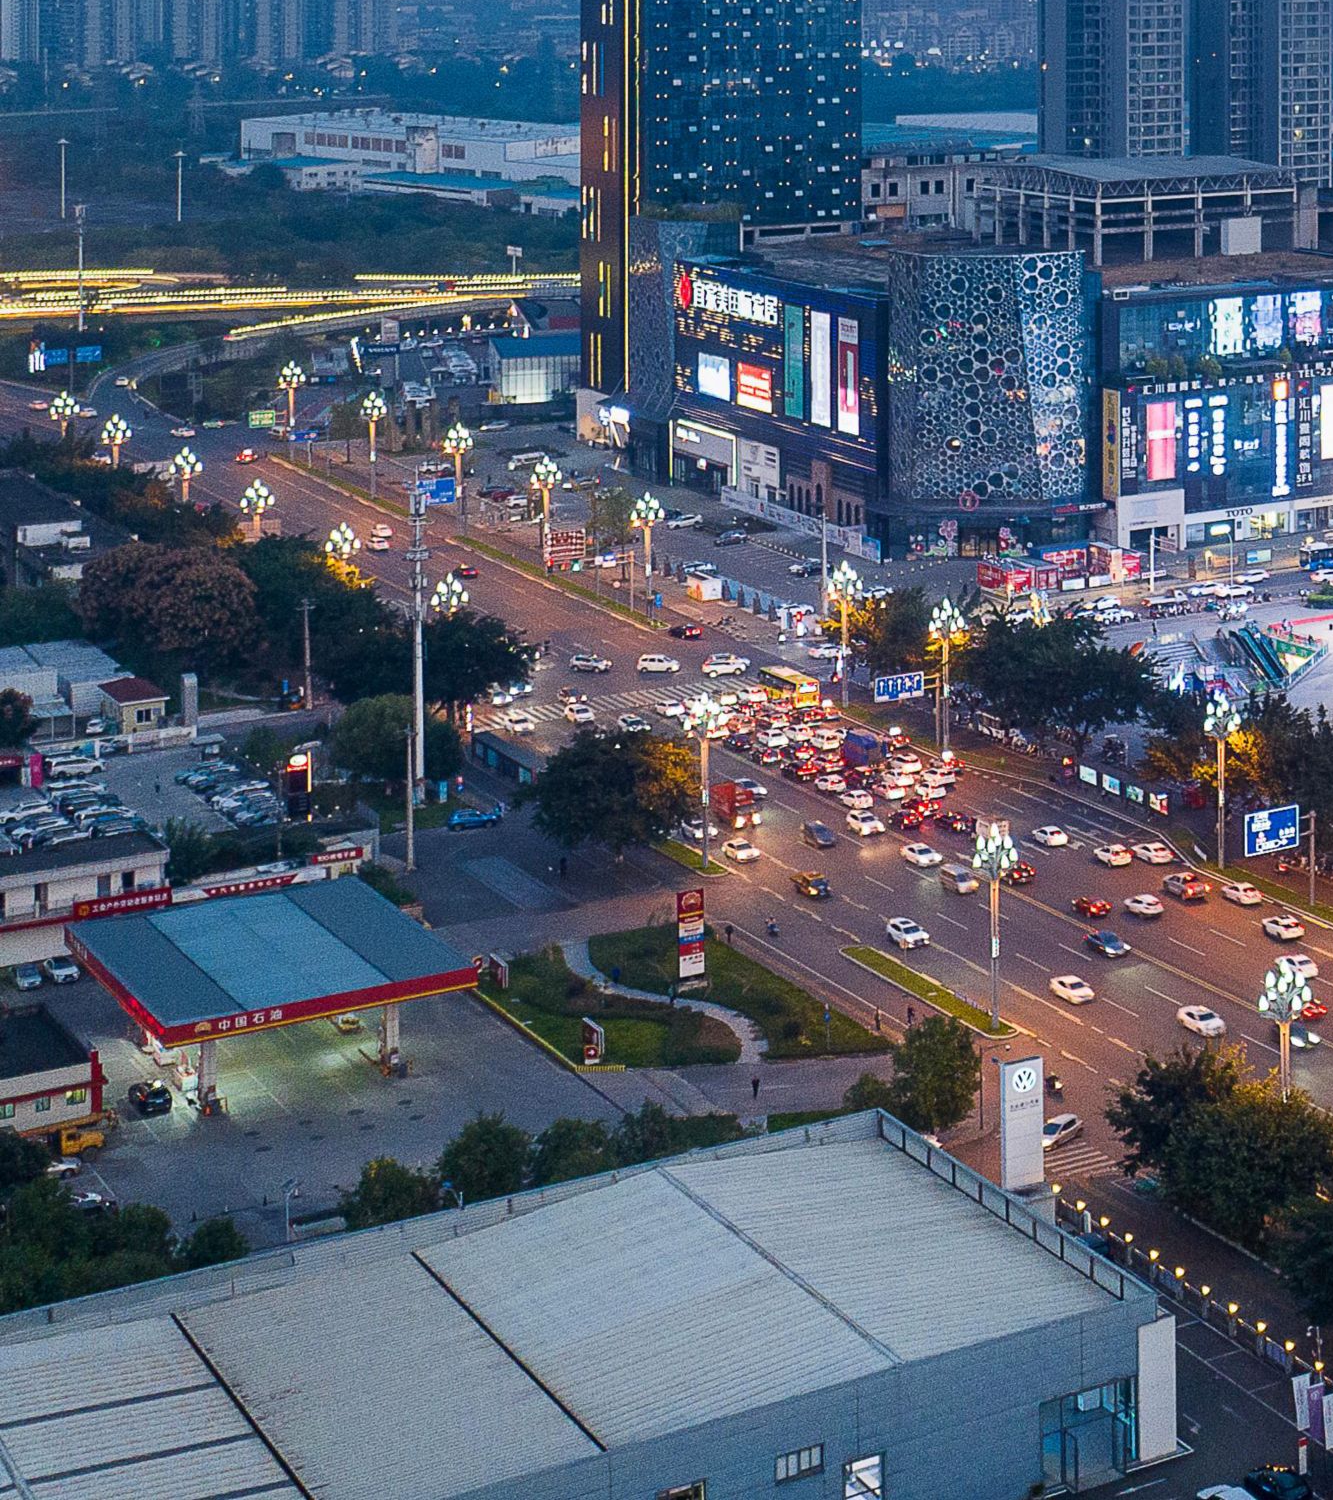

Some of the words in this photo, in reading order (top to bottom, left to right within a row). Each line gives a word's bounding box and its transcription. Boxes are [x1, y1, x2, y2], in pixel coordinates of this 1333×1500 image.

[1225, 507, 1253, 518] TOTO
[218, 1009, 284, 1031] 中国石油
